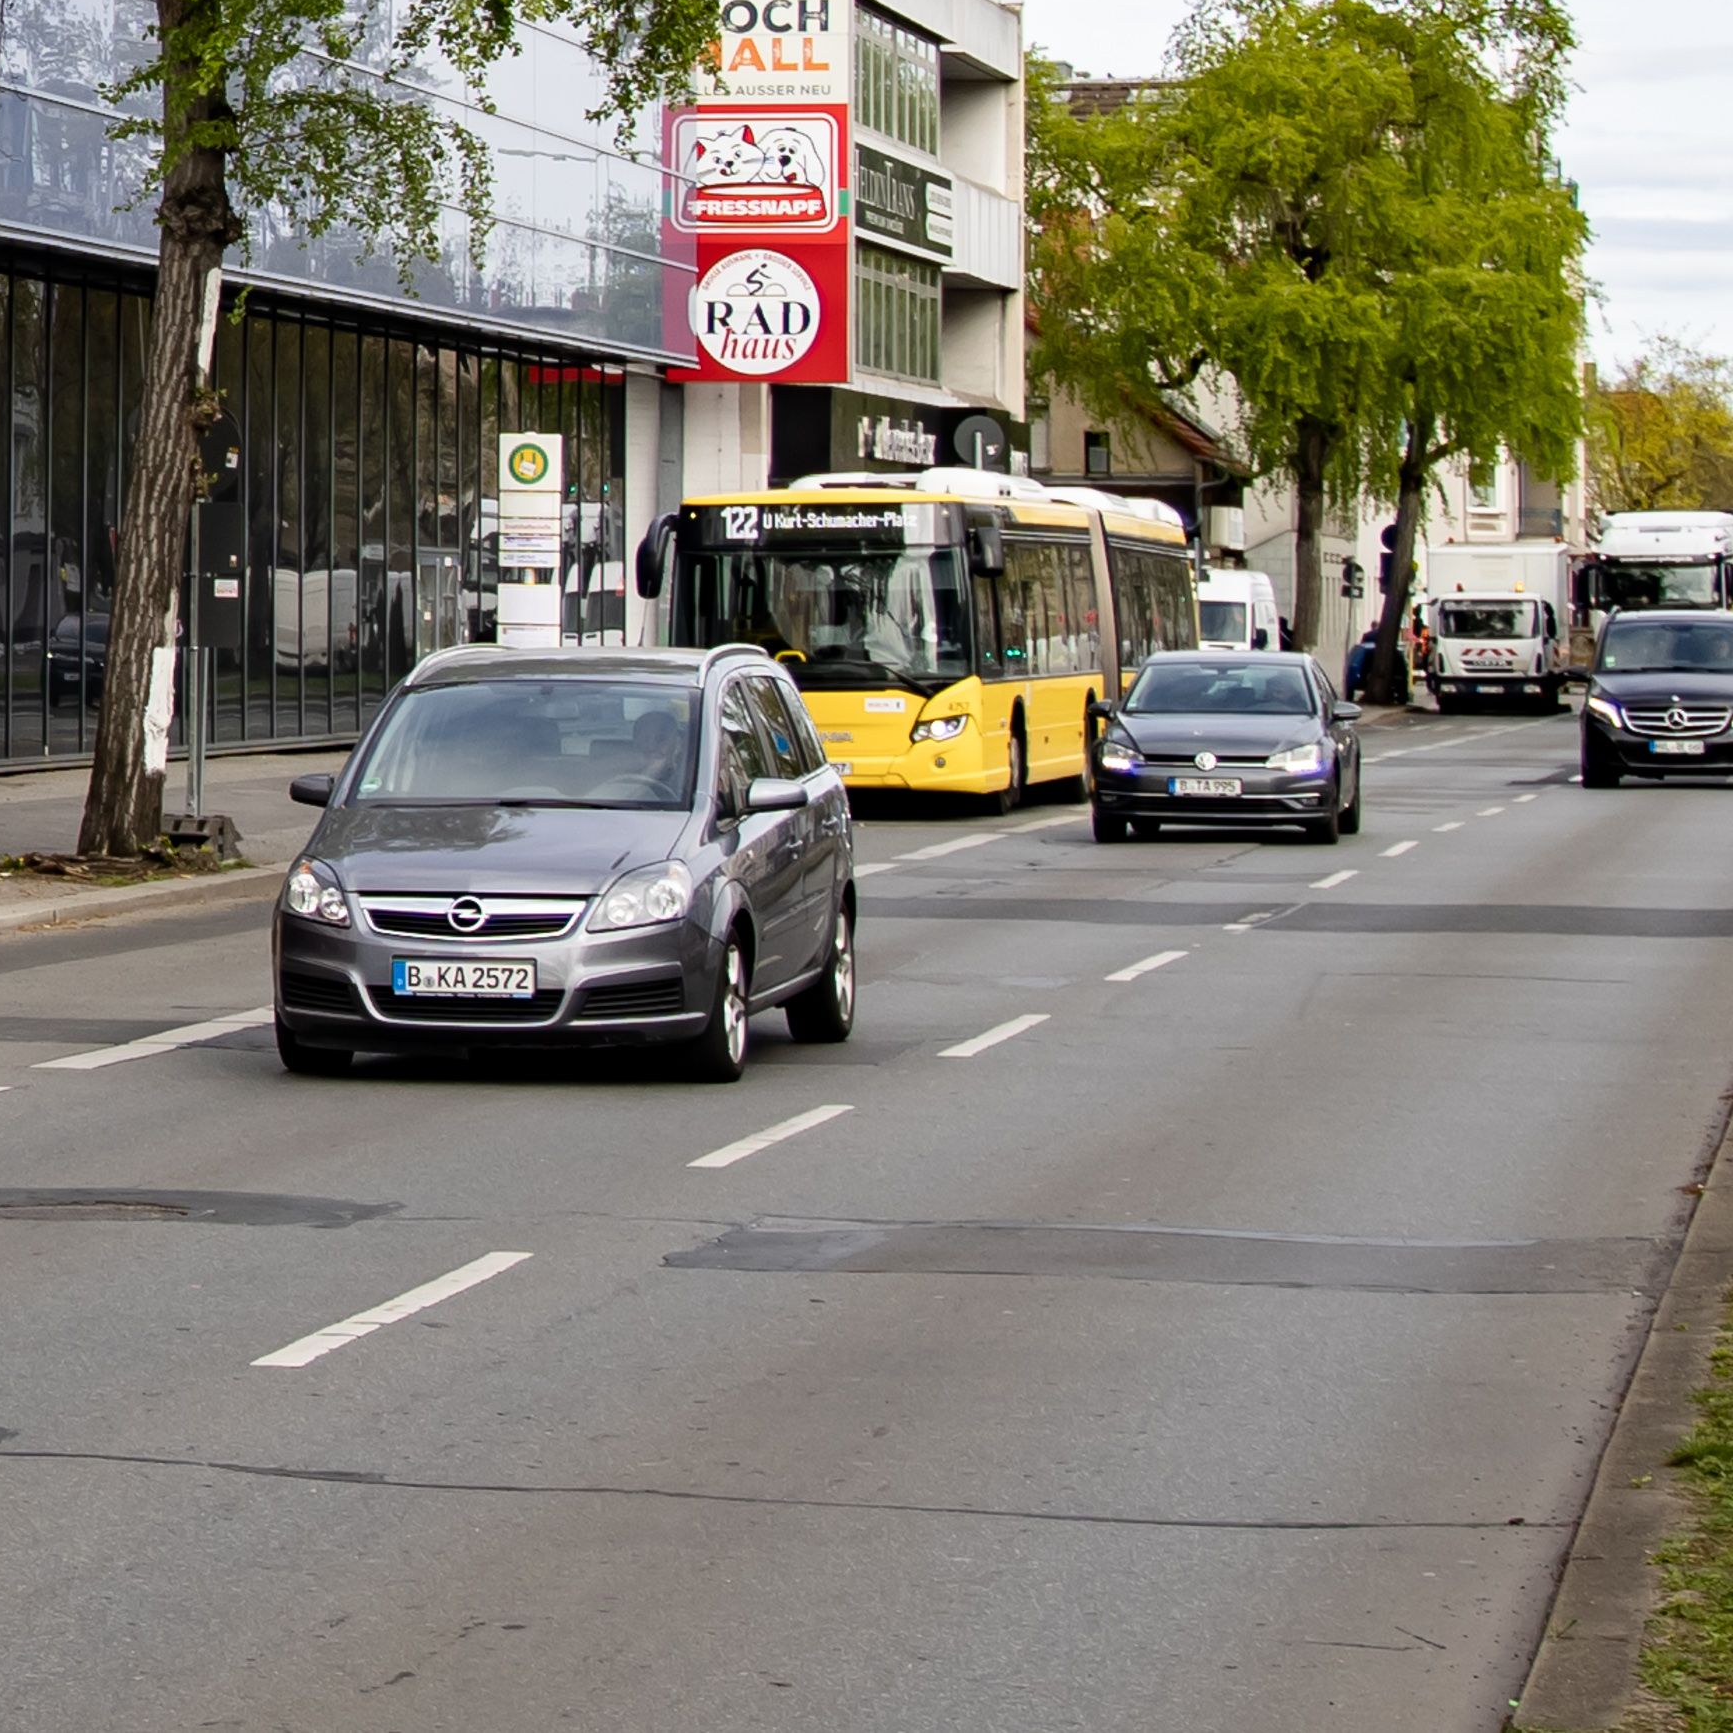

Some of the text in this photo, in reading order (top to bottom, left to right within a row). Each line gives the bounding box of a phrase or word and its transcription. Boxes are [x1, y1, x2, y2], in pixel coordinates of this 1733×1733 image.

[721, 0, 829, 33] OCH
[735, 85, 795, 96] AUSSER
[800, 85, 832, 96] NEU
[690, 199, 822, 216] FRESSNAPF
[704, 301, 811, 335] RAD
[719, 326, 797, 360] haus
[720, 506, 918, 539] 122 U Kurt-Schumacher-Platz
[1179, 781, 1188, 791] B
[1196, 780, 1210, 791] TA
[408, 966, 529, 990] B KA 2572
